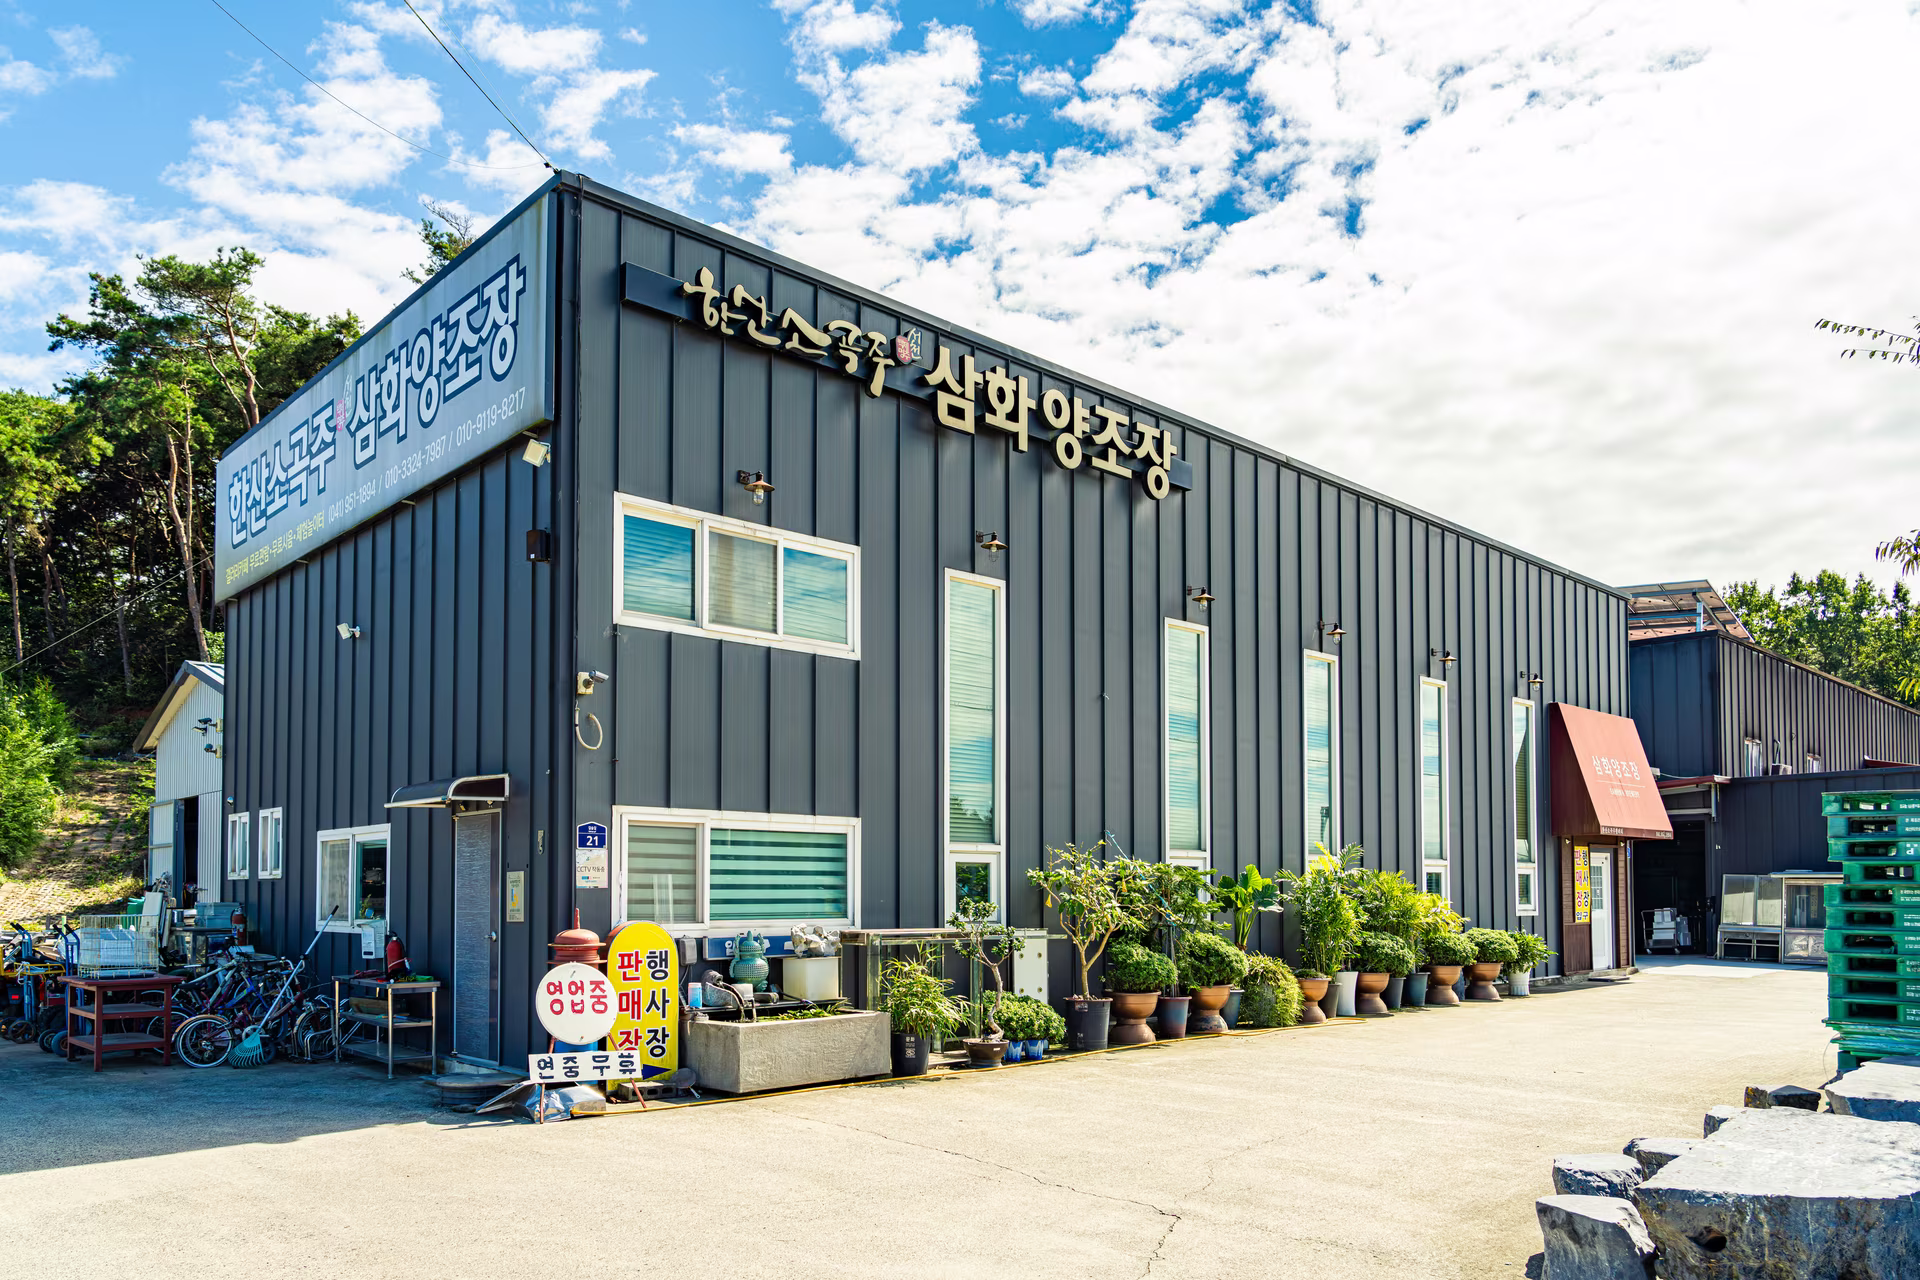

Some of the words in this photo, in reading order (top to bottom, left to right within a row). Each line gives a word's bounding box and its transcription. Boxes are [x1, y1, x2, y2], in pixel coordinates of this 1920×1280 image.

[682, 266, 896, 398] 한산소곡주
[229, 400, 336, 549] 한산소곡주
[347, 254, 526, 470] 삼화양조장
[385, 435, 446, 489] 010-3324-7987
[456, 387, 526, 447] 010-9119-8217
[924, 345, 1177, 500] 삼화양조장
[1592, 756, 1640, 780] 삼화양조장
[586, 835, 598, 846] 21
[546, 980, 608, 1015] 영업중
[645, 949, 670, 1058] 행사장
